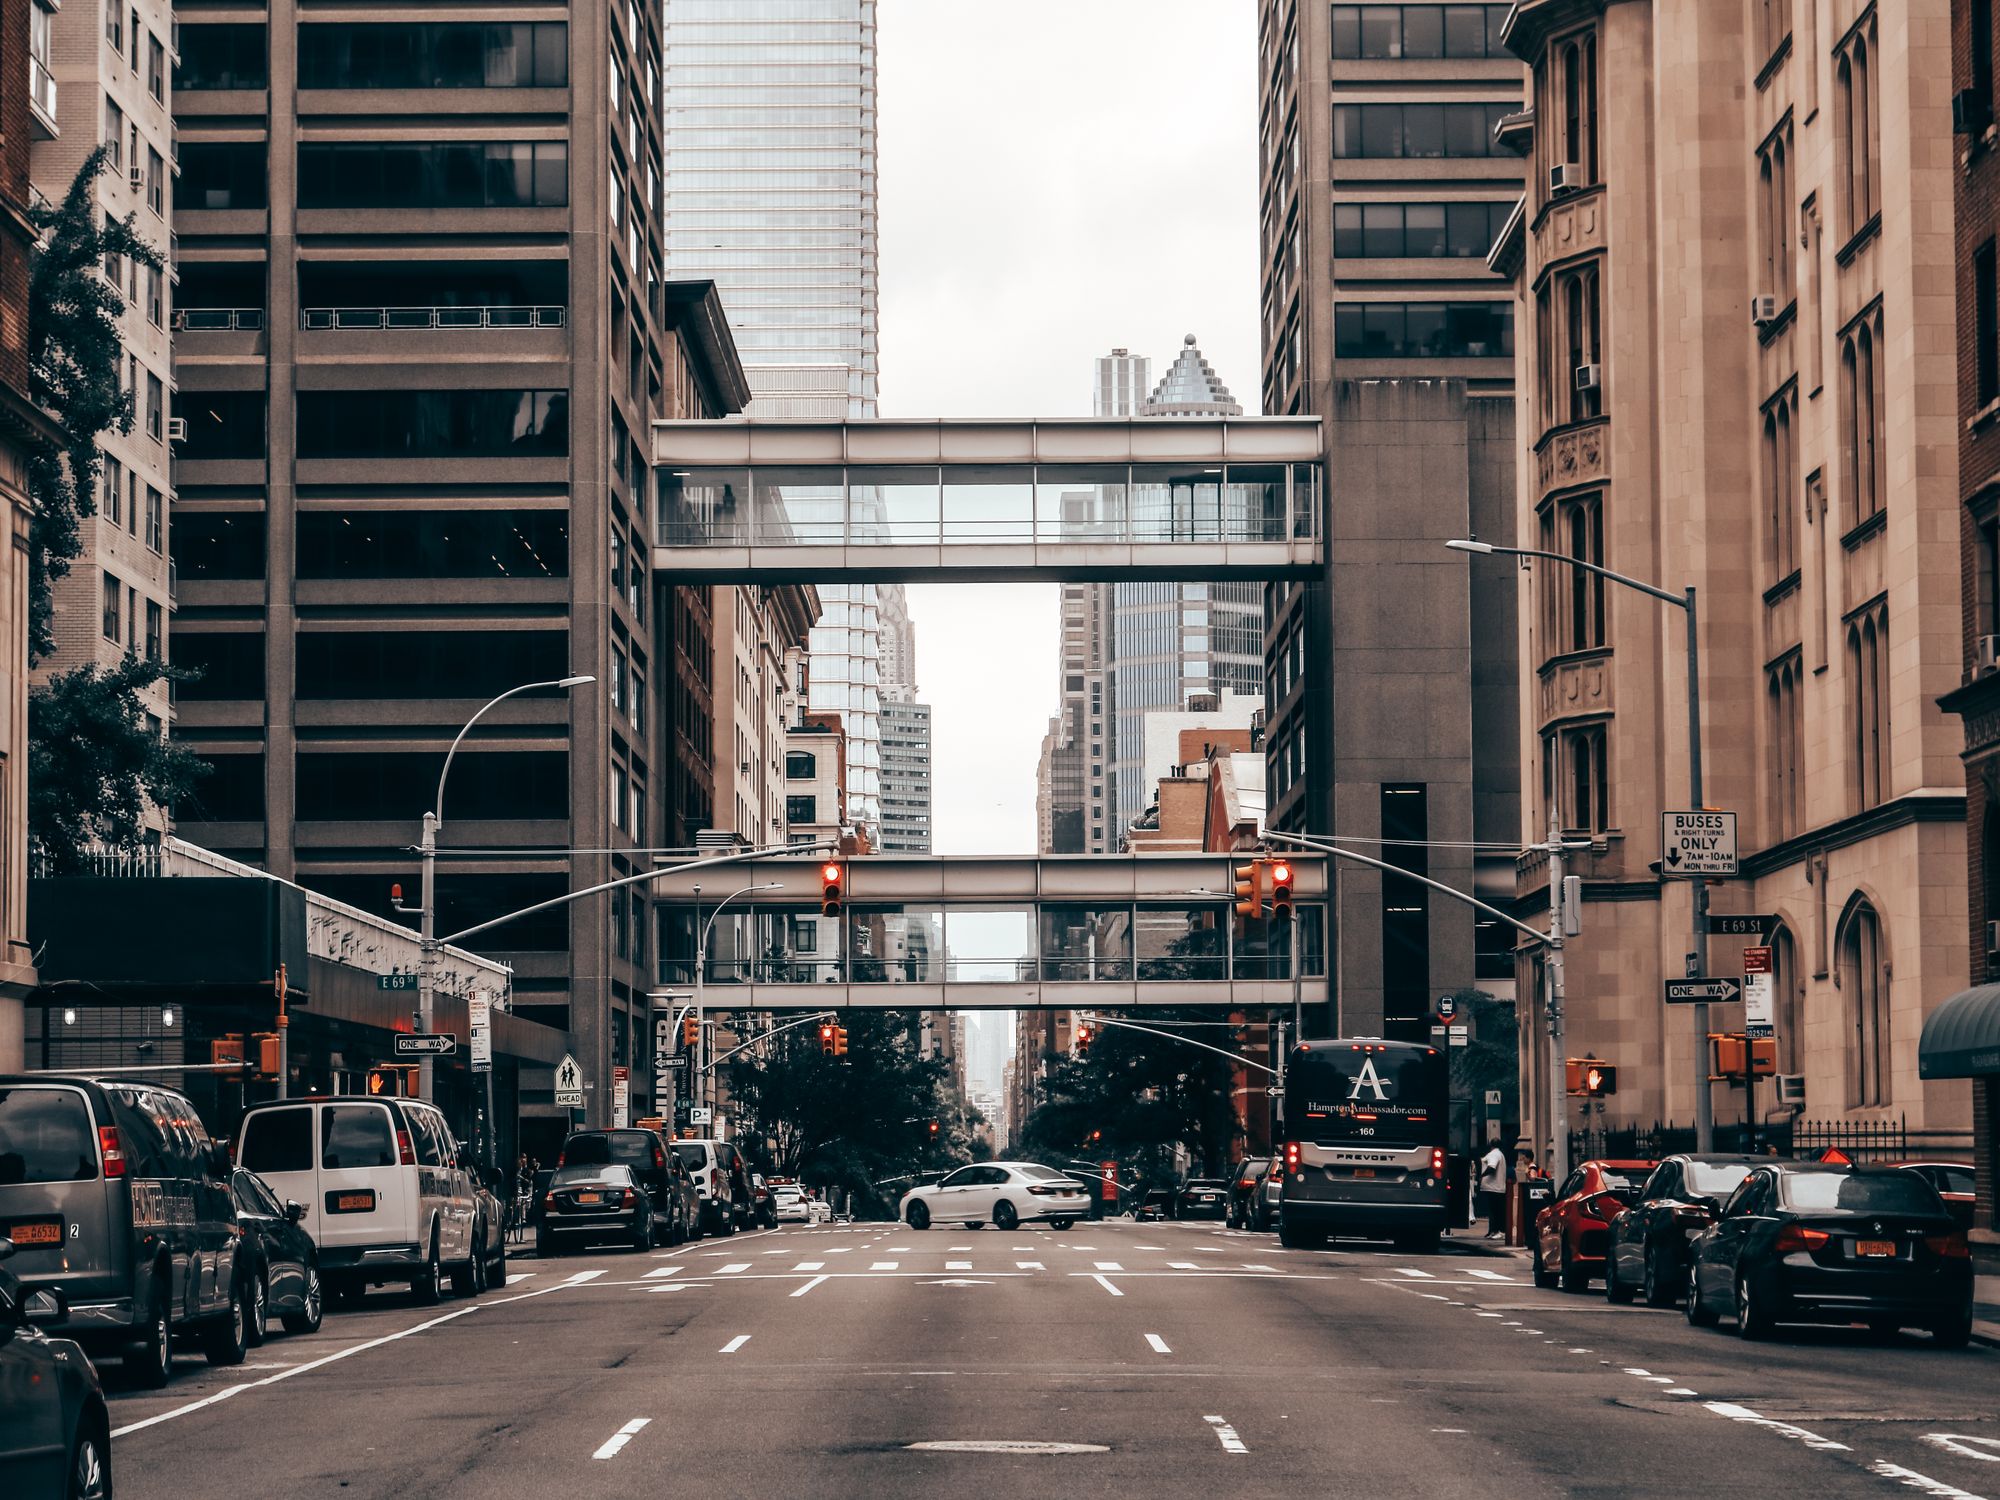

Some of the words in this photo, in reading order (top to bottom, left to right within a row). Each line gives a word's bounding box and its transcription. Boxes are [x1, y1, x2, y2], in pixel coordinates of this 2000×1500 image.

[1676, 815, 1723, 828] BUSES
[1681, 837, 1718, 850] ONLY
[1722, 862, 1735, 871] FRI
[1722, 920, 1728, 932] E
[1732, 920, 1746, 932] 69
[1750, 919, 1761, 932] St
[382, 976, 388, 988] E
[392, 976, 405, 988] 69
[1671, 986, 1695, 996] ONE
[1706, 985, 1731, 995] WAY
[400, 1041, 419, 1049] ONE
[428, 1040, 448, 1049] WAY
[1346, 1057, 1390, 1100] A
[557, 1095, 580, 1103] AHEAD
[1308, 1102, 1427, 1115] HamptonAmbassador.com
[693, 1111, 701, 1121] P
[1359, 1128, 1375, 1136] 160
[71, 1225, 78, 1238] 2
